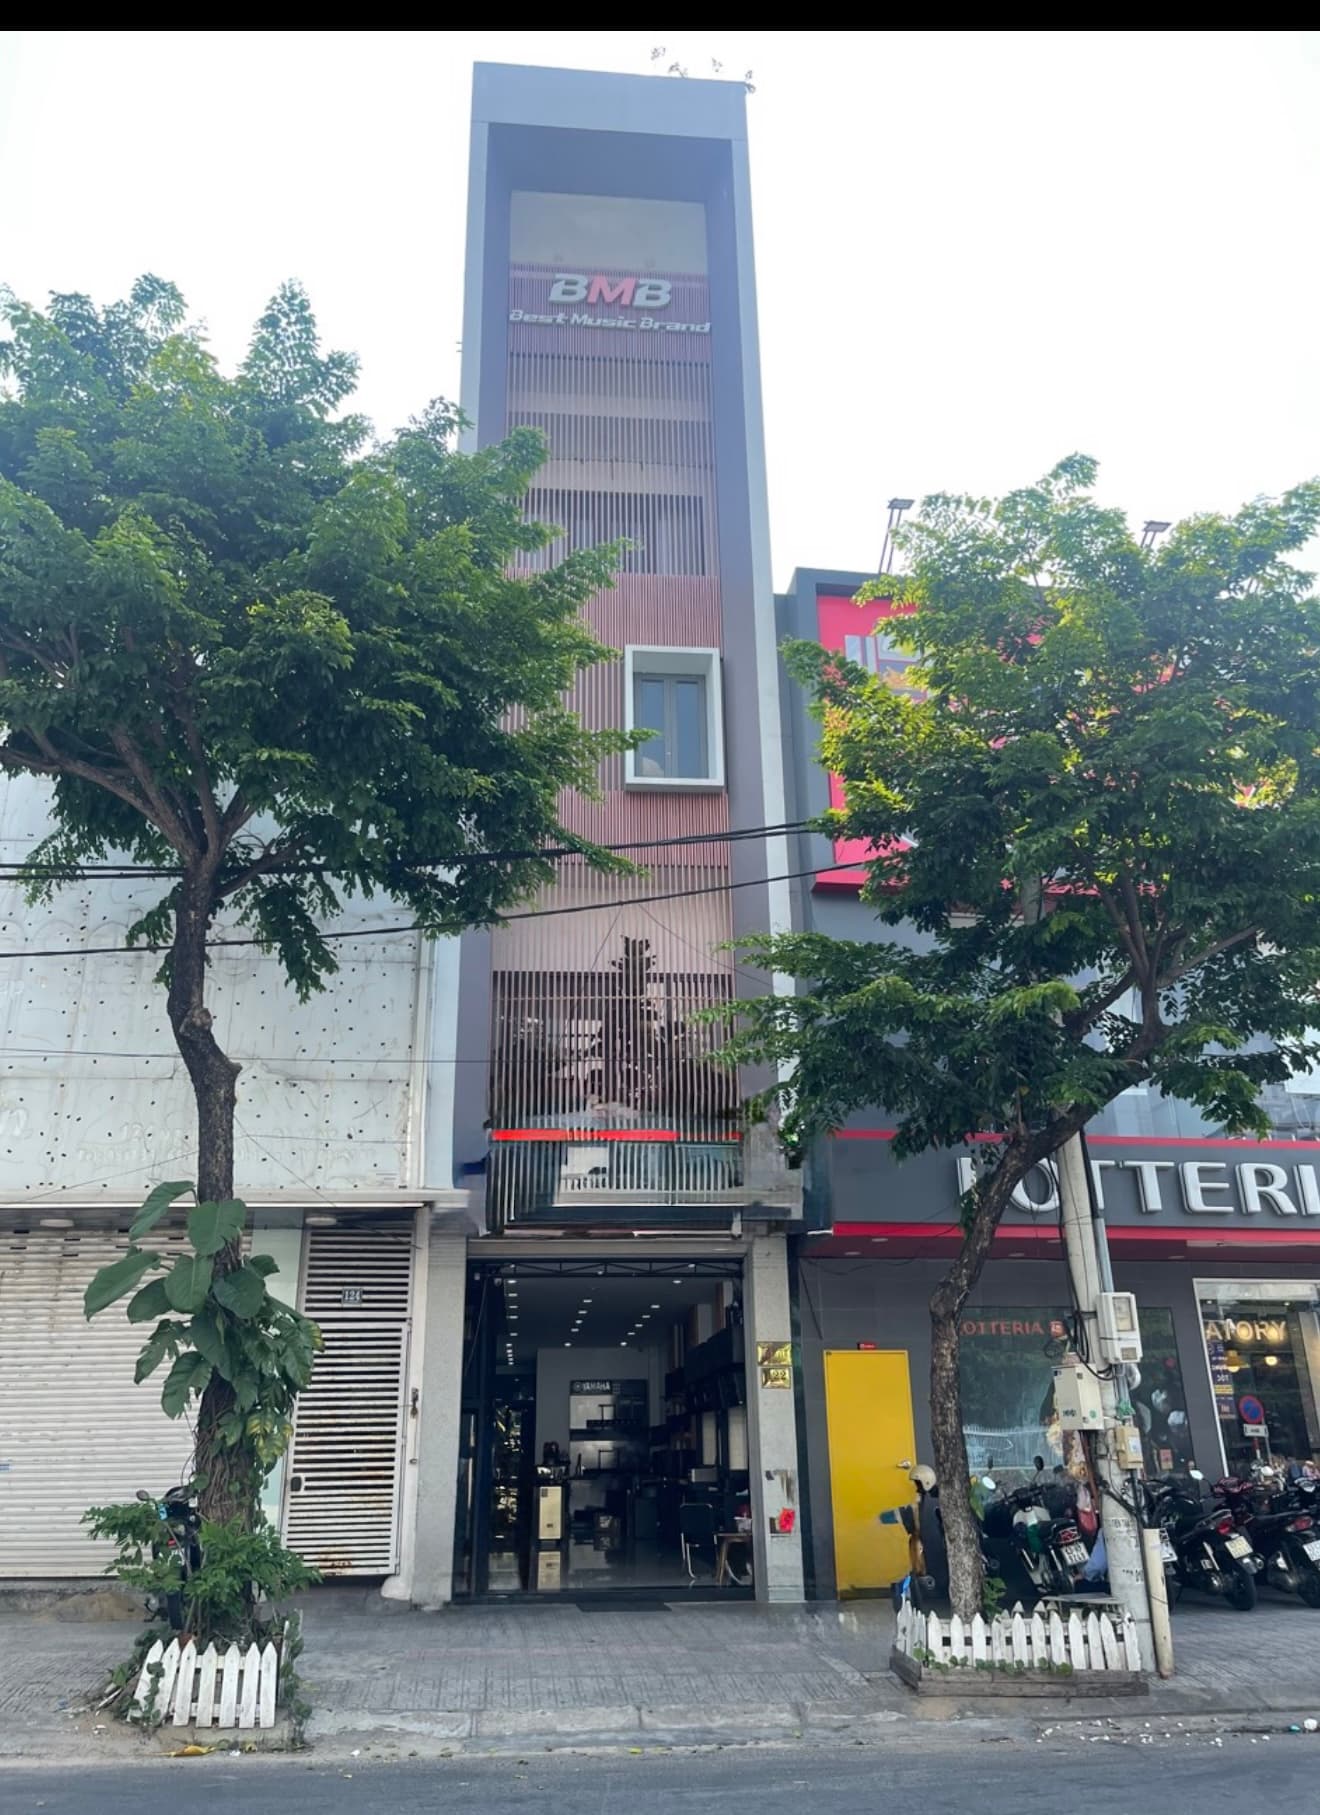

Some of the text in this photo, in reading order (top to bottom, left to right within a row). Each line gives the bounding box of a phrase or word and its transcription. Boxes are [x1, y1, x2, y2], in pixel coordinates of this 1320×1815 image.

[548, 272, 672, 310] BMB
[509, 308, 712, 334] Best Music Brand
